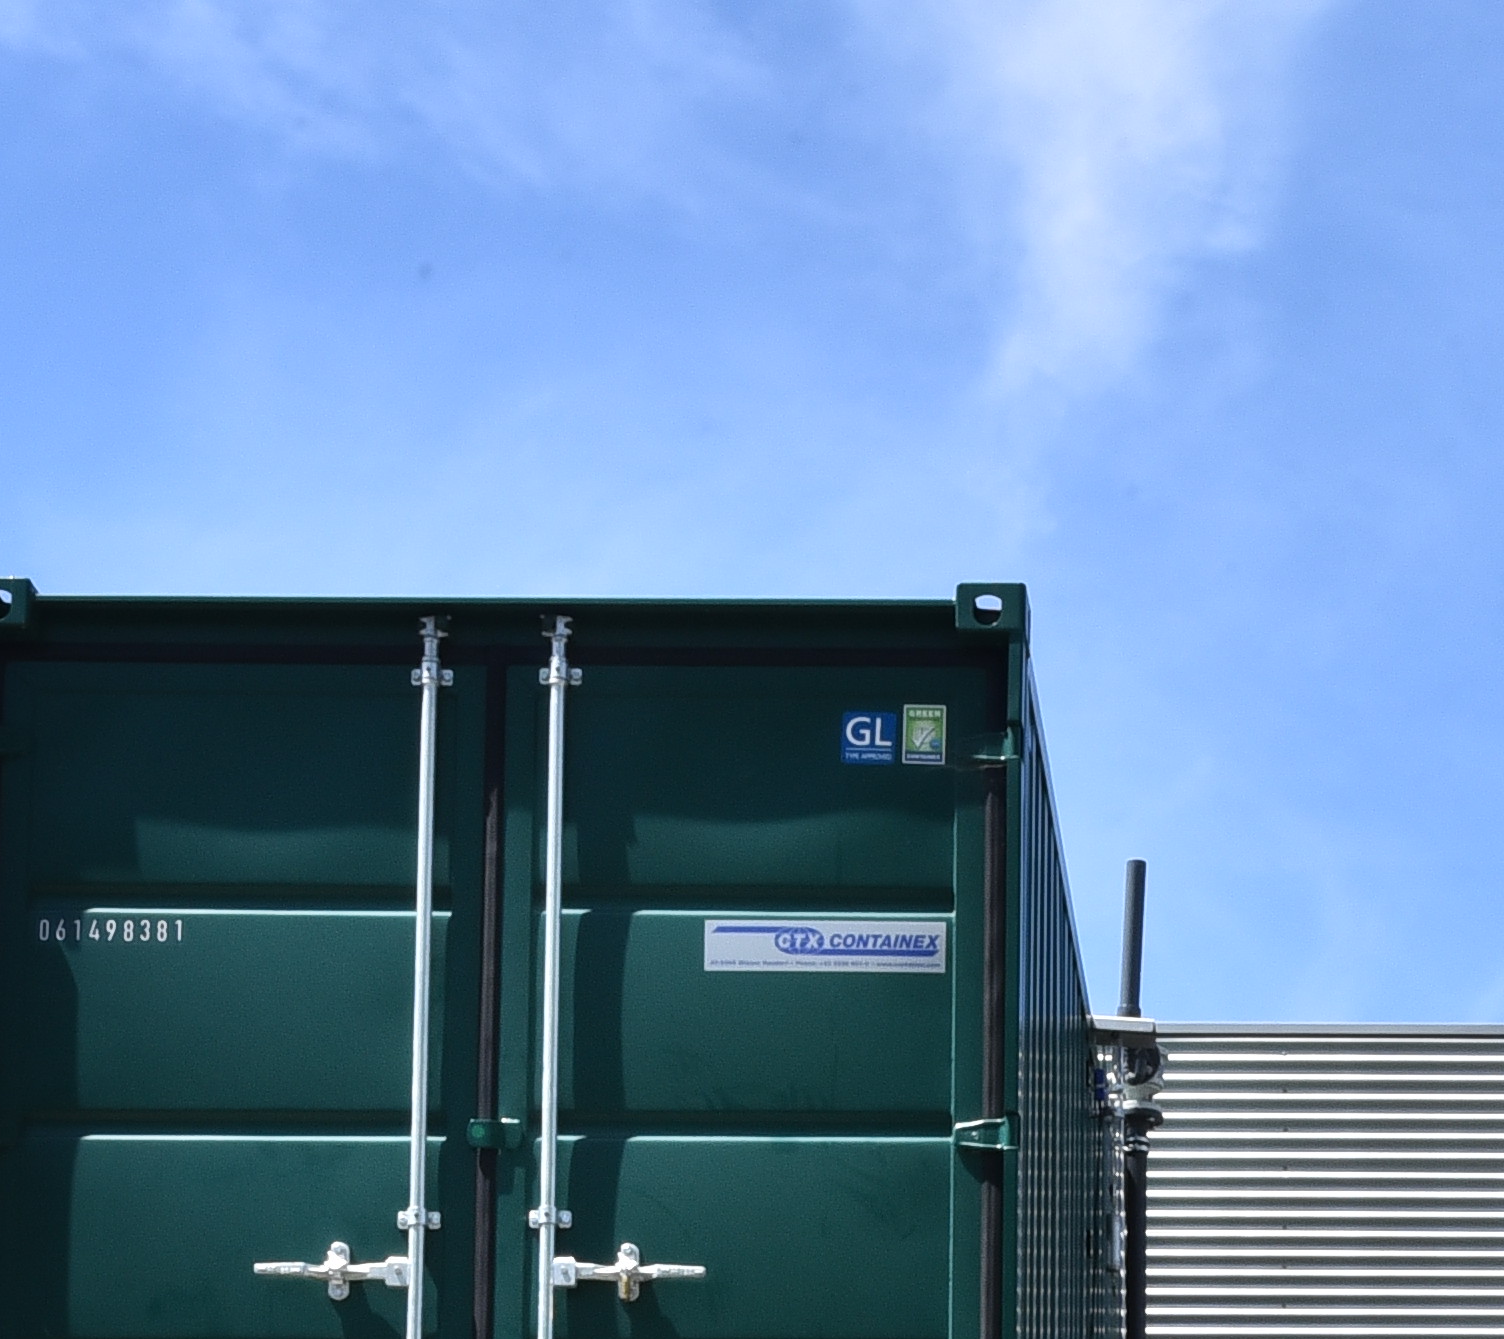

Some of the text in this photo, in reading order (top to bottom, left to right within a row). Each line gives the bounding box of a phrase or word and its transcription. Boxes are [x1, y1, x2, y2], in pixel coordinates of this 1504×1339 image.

[845, 716, 893, 746] GL
[38, 918, 183, 942] 061498381
[777, 931, 941, 950] CTX CONTAINEX
